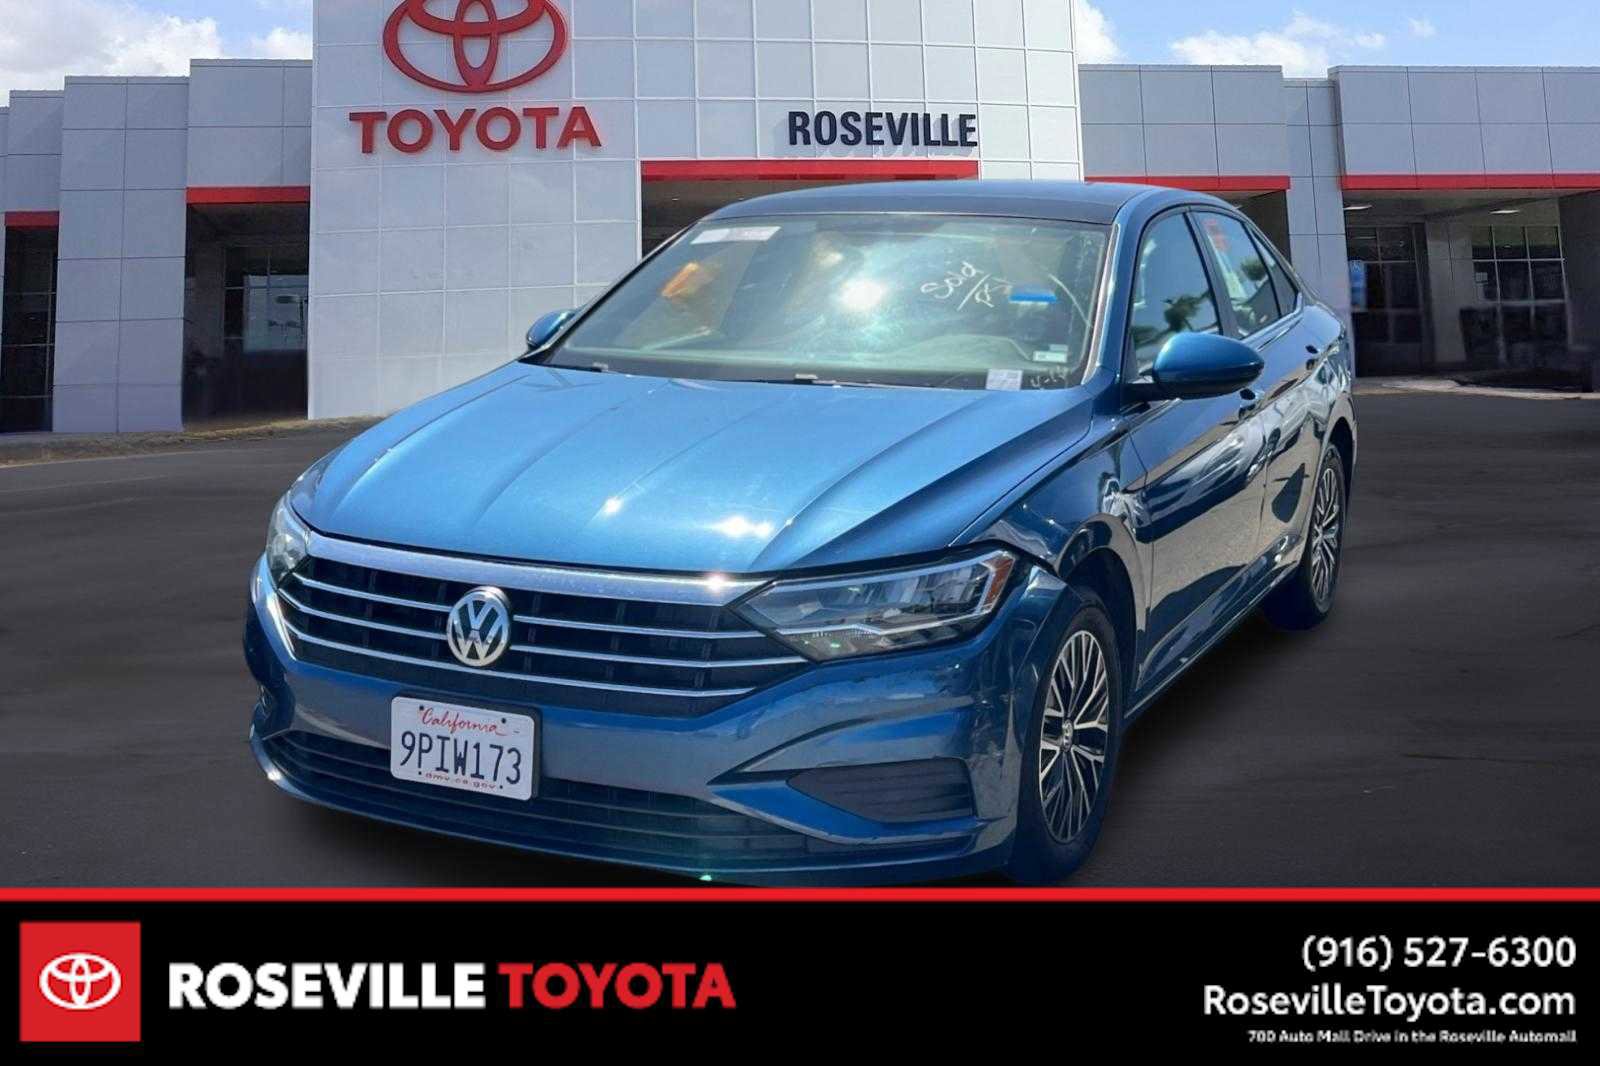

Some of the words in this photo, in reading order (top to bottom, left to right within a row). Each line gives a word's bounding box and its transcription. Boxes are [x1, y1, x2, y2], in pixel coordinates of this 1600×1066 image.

[349, 106, 602, 153] TOYOTA
[788, 110, 978, 147] ROSEVILLE
[420, 707, 508, 737] California
[399, 730, 522, 785] 9PIW173
